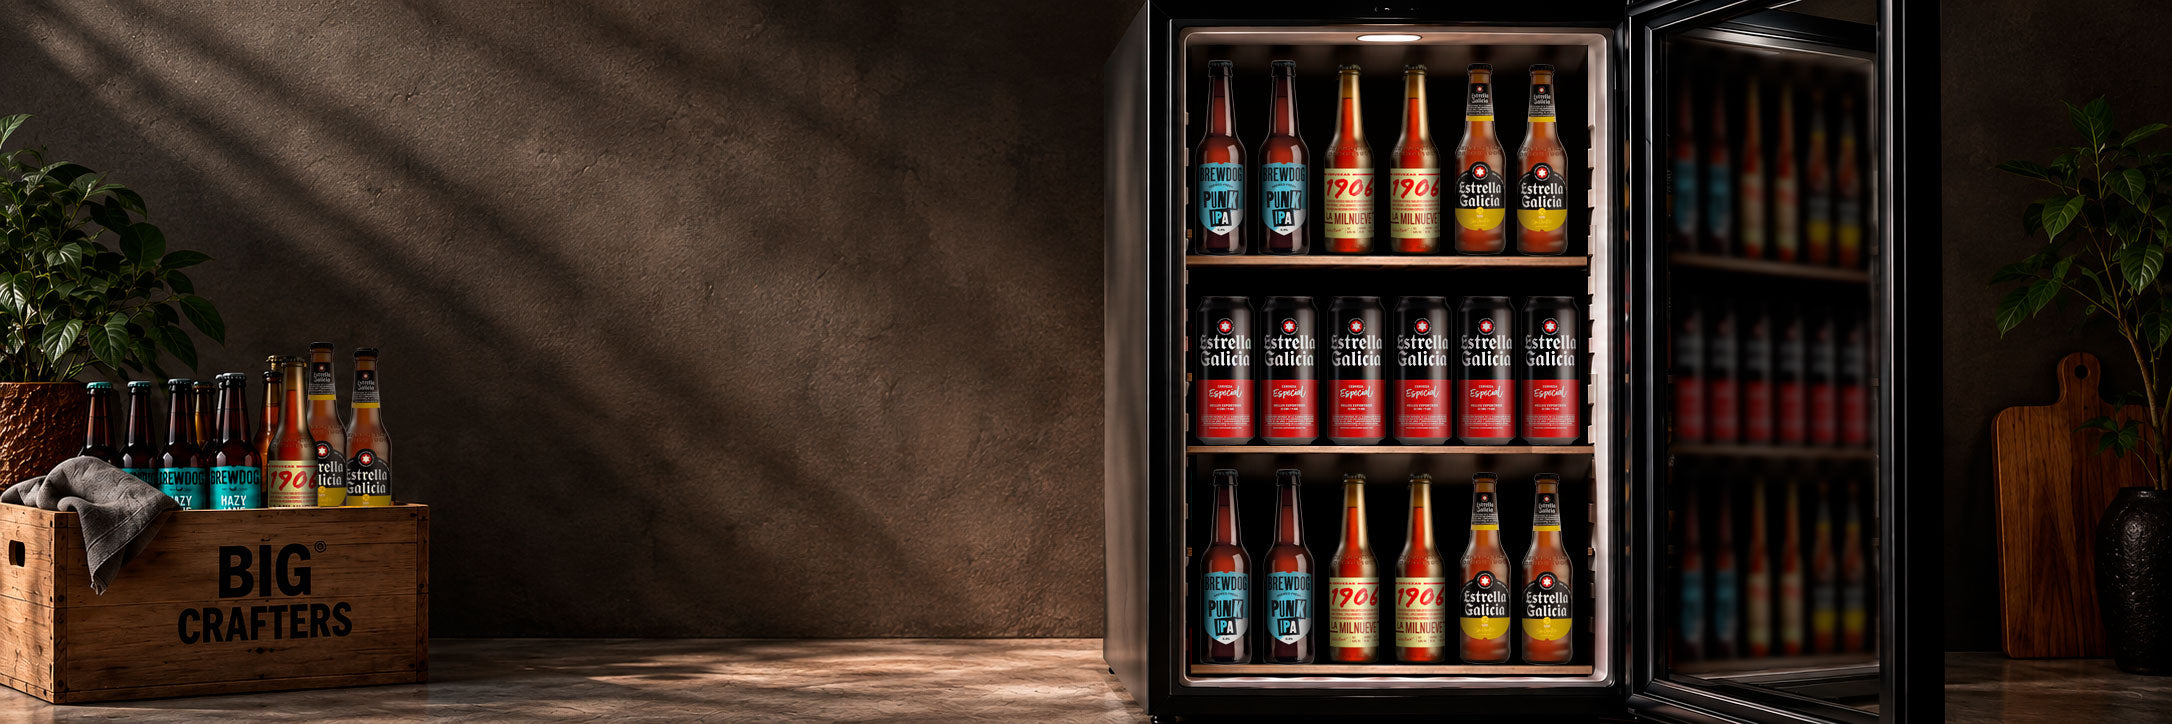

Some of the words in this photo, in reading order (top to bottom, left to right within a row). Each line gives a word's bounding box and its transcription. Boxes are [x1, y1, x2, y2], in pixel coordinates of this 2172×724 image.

[1200, 167, 1243, 182] BREWDOG
[1263, 167, 1306, 182] BREWDOG
[1326, 177, 1374, 199] 1906
[1392, 177, 1440, 199] 1906
[1459, 181, 1501, 194] Estrella
[1521, 182, 1563, 195] Estrella
[1203, 190, 1239, 209] PUNK
[1266, 190, 1301, 209] PUNK
[1459, 194, 1500, 207] Galicia
[1521, 195, 1562, 208] Galicia
[1210, 210, 1230, 226] IPA
[1273, 210, 1293, 226] IPA
[1200, 334, 1251, 350] Estrella
[1264, 334, 1315, 350] Estrella
[1331, 334, 1382, 350] Estrella
[1397, 334, 1448, 350] Estrella
[1461, 334, 1512, 350] Estrella
[1525, 334, 1576, 350] Estrella
[1200, 350, 1250, 367] Galicia
[1264, 350, 1314, 367] Galicia
[1331, 350, 1381, 367] Galicia
[1397, 350, 1447, 367] Galicia
[1461, 350, 1511, 367] Galicia
[1525, 350, 1575, 367] Galicia
[1209, 385, 1242, 399] Especial
[1273, 385, 1306, 399] Especial
[1340, 385, 1373, 399] Especial
[1406, 385, 1439, 399] Especial
[1470, 385, 1503, 399] Especial
[1534, 385, 1567, 399] Especial
[318, 461, 343, 473] rella
[210, 469, 260, 485] BREWDOG
[270, 469, 317, 492] 1906
[318, 473, 342, 486] licia
[173, 495, 192, 506] AZY
[221, 494, 247, 506] HAZY
[218, 542, 312, 598] BIG
[1204, 576, 1248, 591] BREWDOG
[1267, 576, 1311, 591] BREWDOG
[1331, 586, 1379, 608] 1906
[1397, 586, 1445, 608] 1906
[1464, 590, 1507, 603] Estrella
[1526, 591, 1569, 604] Estrella
[1208, 599, 1244, 619] PUNK
[1271, 599, 1306, 619] PUNK
[1464, 603, 1505, 616] Galicia
[1526, 604, 1567, 617] Galicia
[177, 601, 353, 645] CRAFTERS
[1215, 619, 1235, 635] IPA
[1278, 619, 1298, 635] IPA
